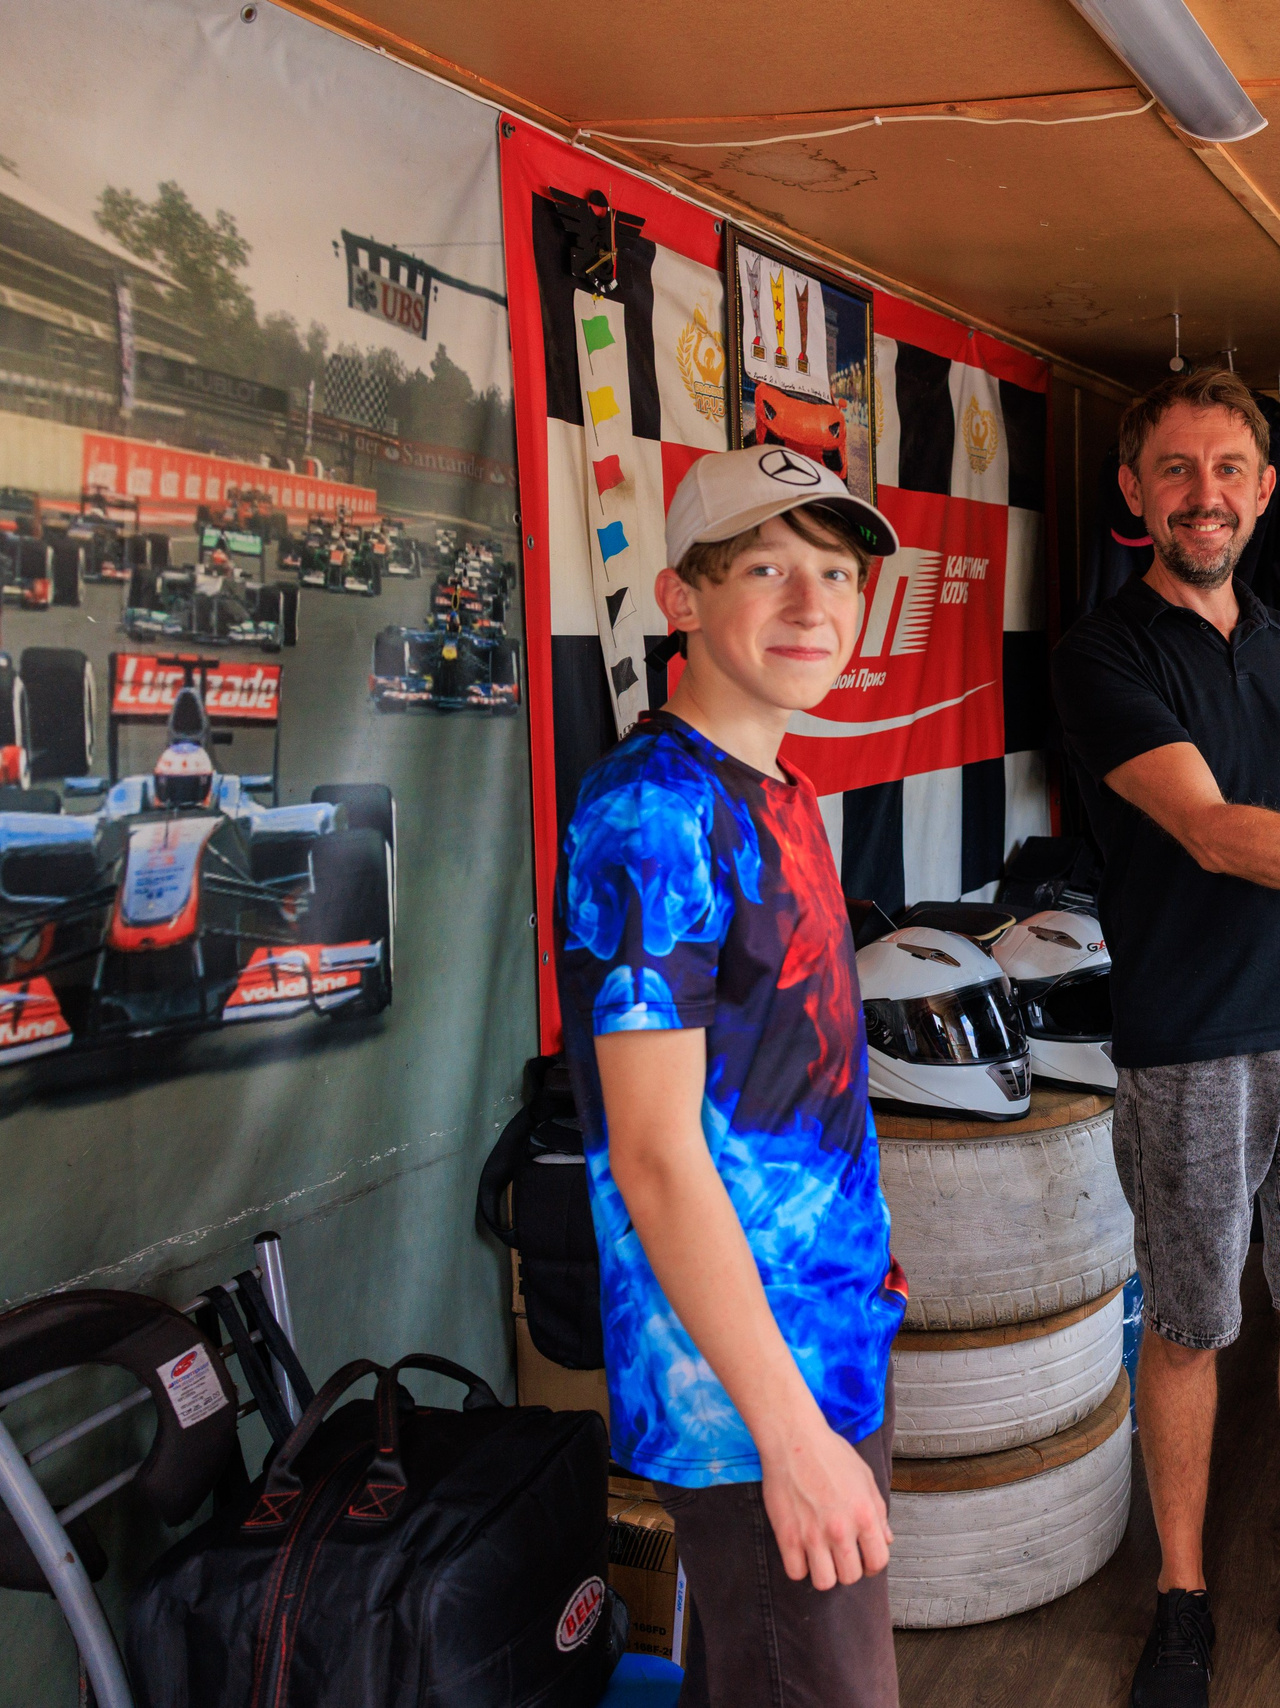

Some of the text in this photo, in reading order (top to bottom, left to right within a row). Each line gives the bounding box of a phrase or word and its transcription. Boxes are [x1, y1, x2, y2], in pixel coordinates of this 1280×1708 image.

[380, 283, 424, 332] UBS
[402, 445, 484, 479] Santander
[945, 555, 989, 580] КАРТИНГ
[940, 581, 969, 604] КЛУБ
[118, 658, 278, 709] Luczade
[855, 668, 887, 692] Приз
[565, 1586, 600, 1638] BELL
[633, 1622, 667, 1636] 168FD
